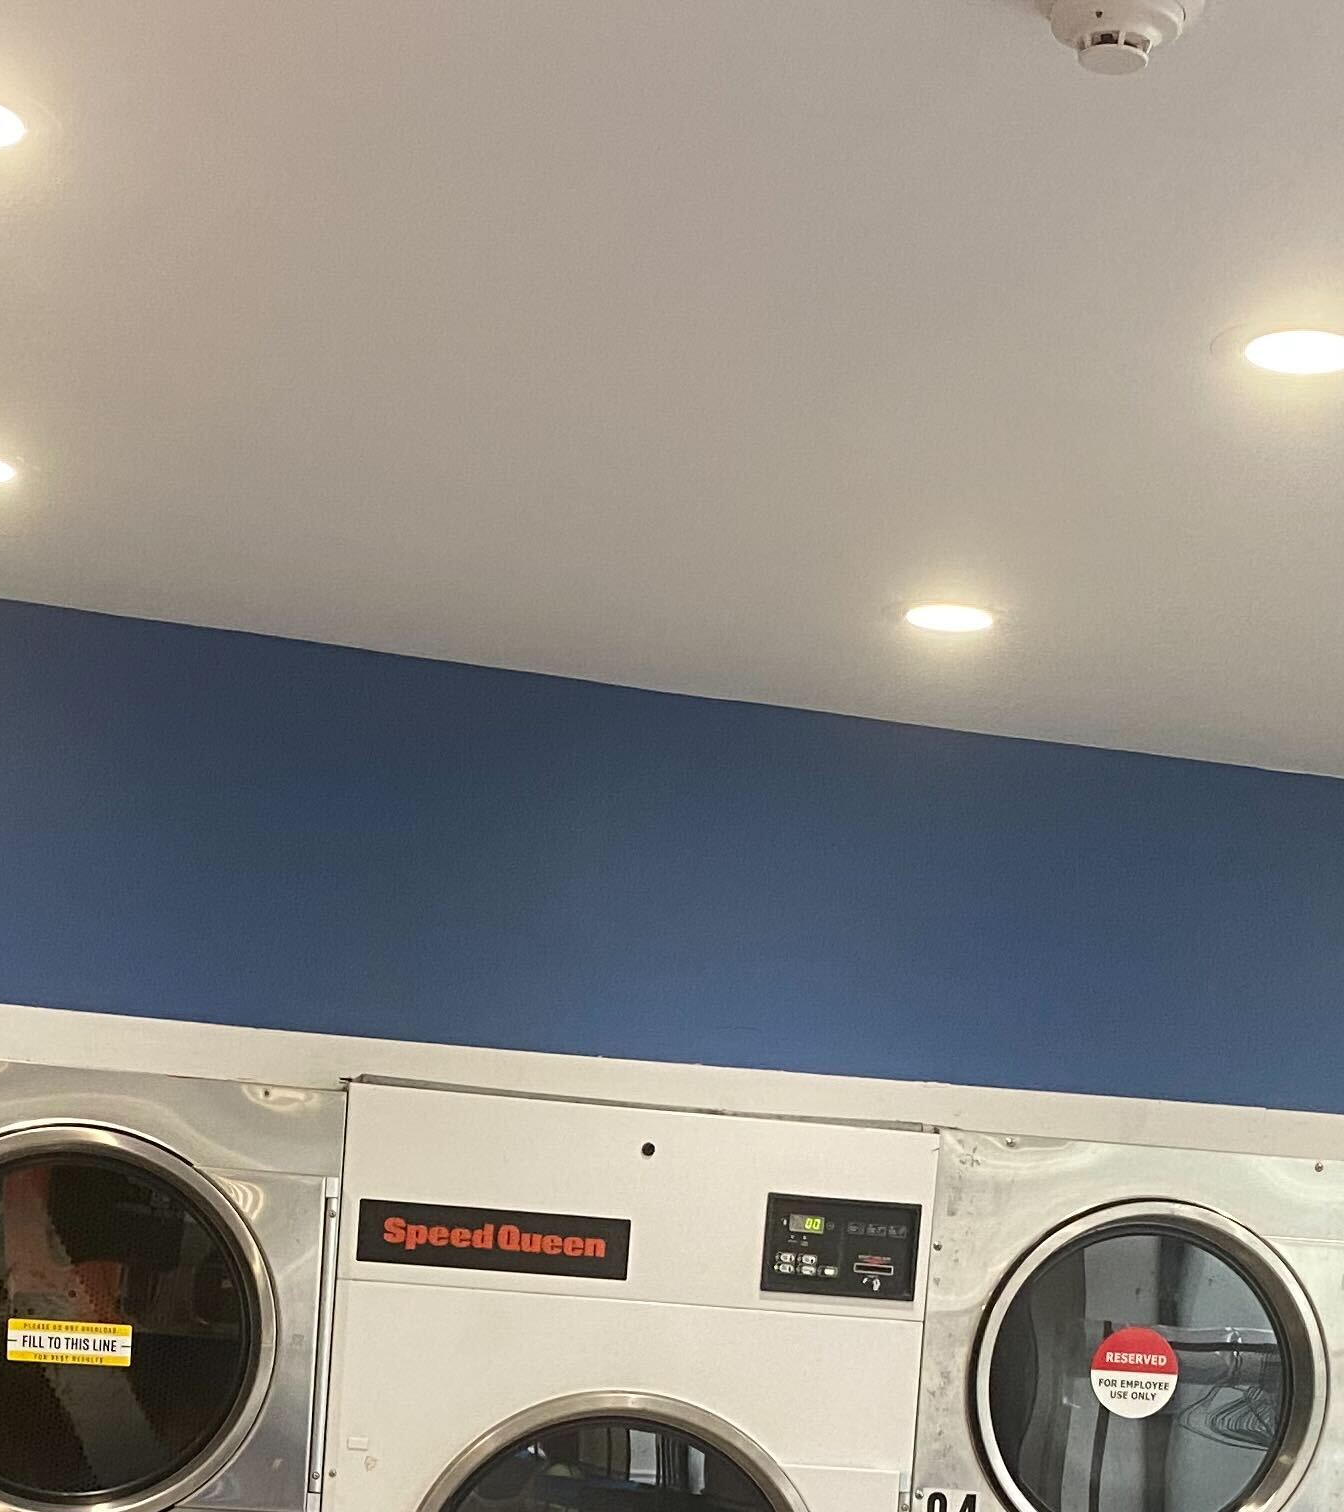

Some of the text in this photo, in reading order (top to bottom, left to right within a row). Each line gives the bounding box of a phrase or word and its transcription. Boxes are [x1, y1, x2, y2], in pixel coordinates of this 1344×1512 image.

[383, 1216, 606, 1258] Speed Queen
[22, 1335, 117, 1352] FILL TO THIS LINE
[1105, 1351, 1167, 1366] RESERVED
[1098, 1378, 1170, 1391] FOR EMPLOYEE
[1110, 1390, 1157, 1401] USE ONLY
